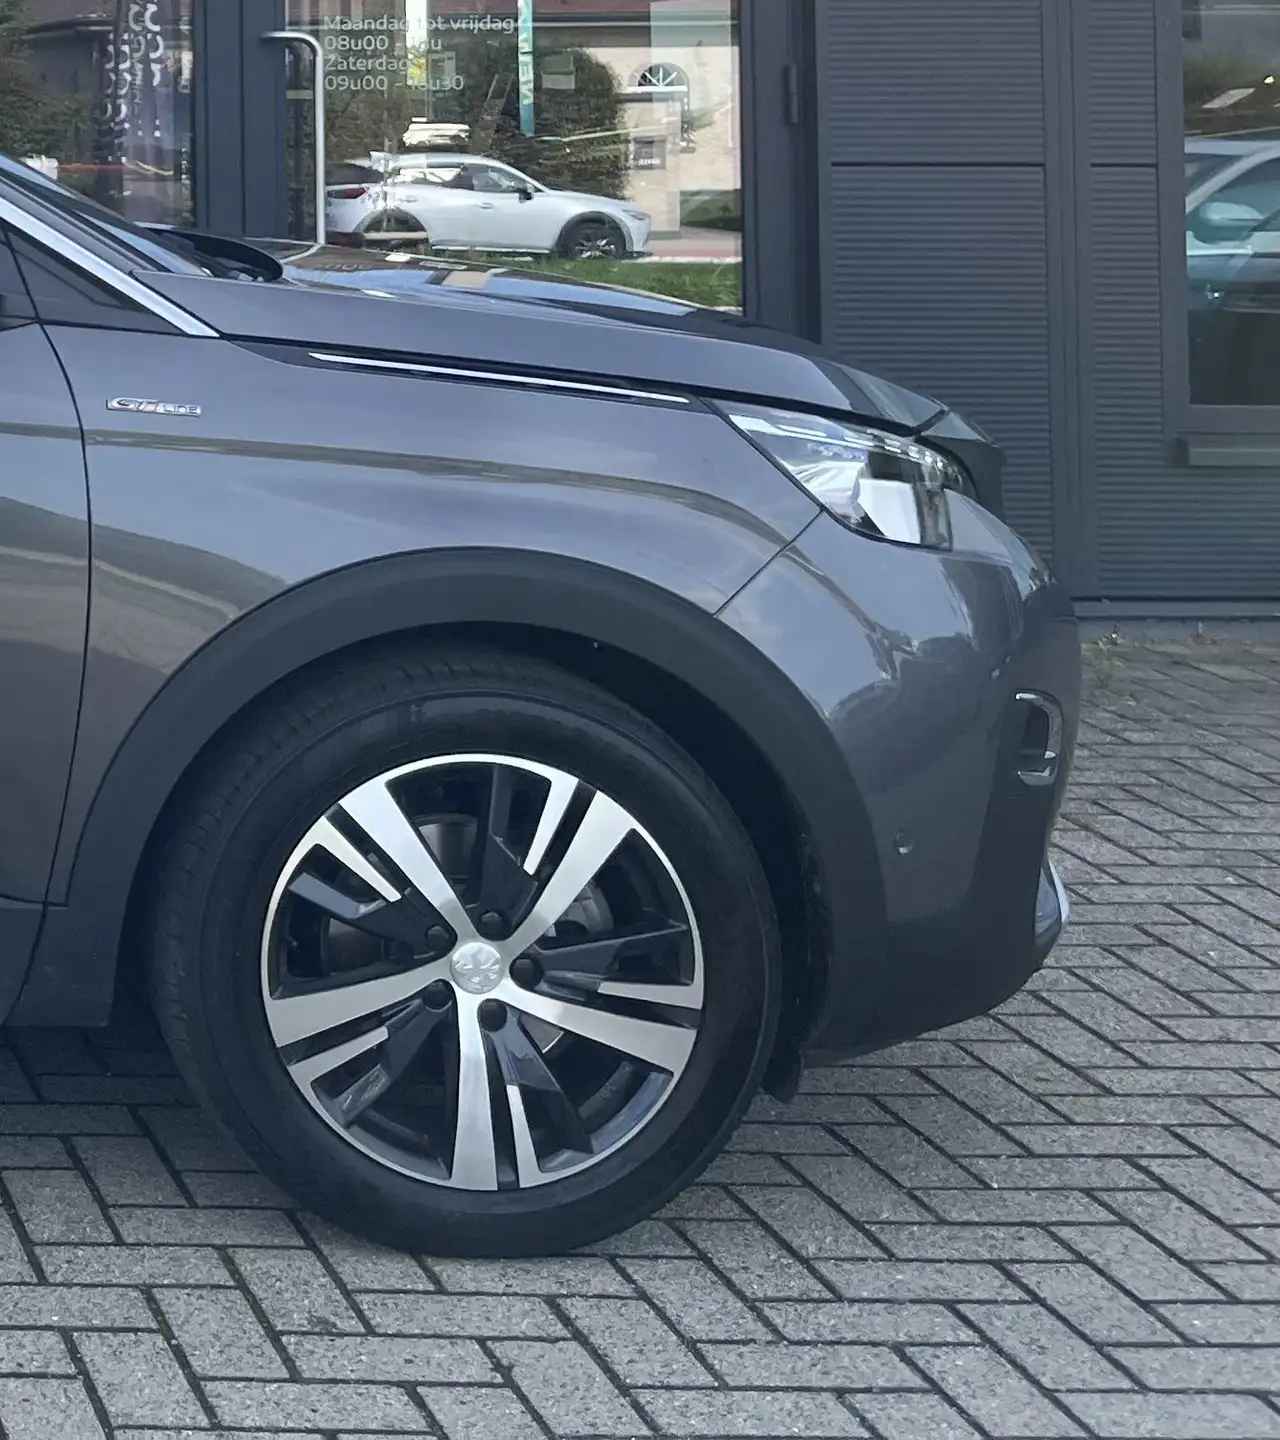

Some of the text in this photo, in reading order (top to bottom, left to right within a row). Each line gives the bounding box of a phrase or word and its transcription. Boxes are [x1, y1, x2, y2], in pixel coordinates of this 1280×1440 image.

[324, 14, 515, 34] Maandag tot vrijdag
[324, 35, 389, 51] 08u00
[324, 54, 412, 74] Zaterdag
[324, 75, 388, 91] 09u00
